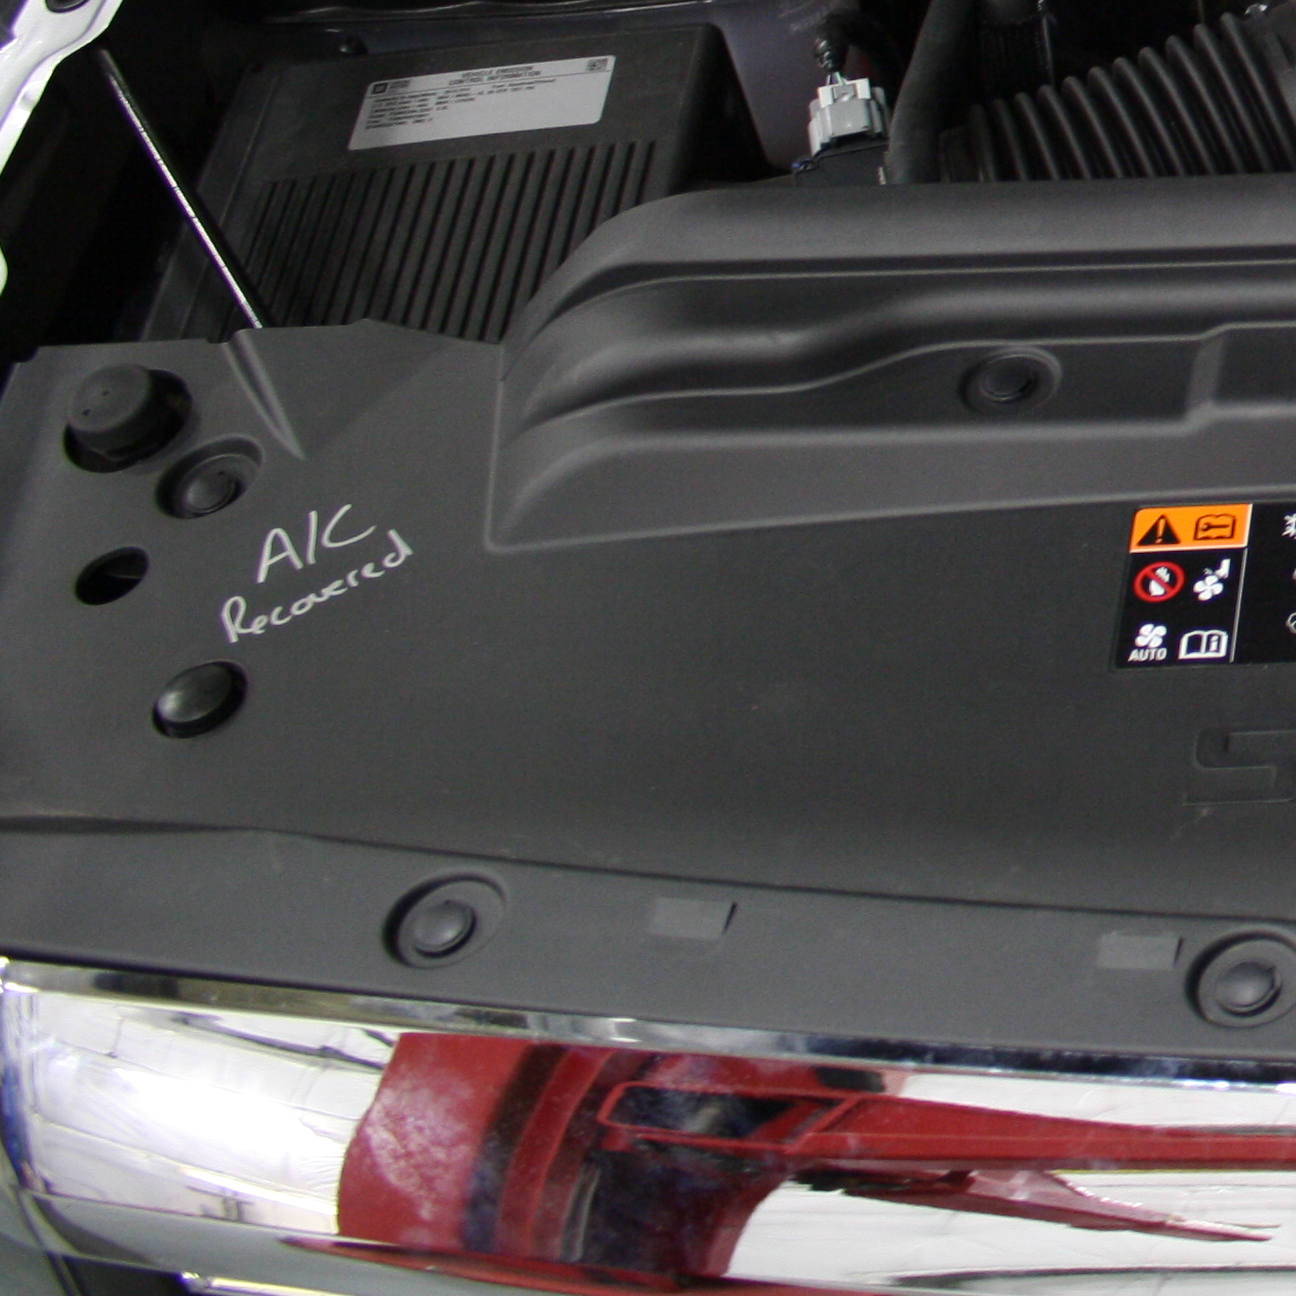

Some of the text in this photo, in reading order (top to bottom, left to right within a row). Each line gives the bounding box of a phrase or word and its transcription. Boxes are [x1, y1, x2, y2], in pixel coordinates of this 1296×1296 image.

[257, 504, 377, 583] A/C
[221, 527, 413, 643] Recovered
[1128, 648, 1167, 661] AUTO
